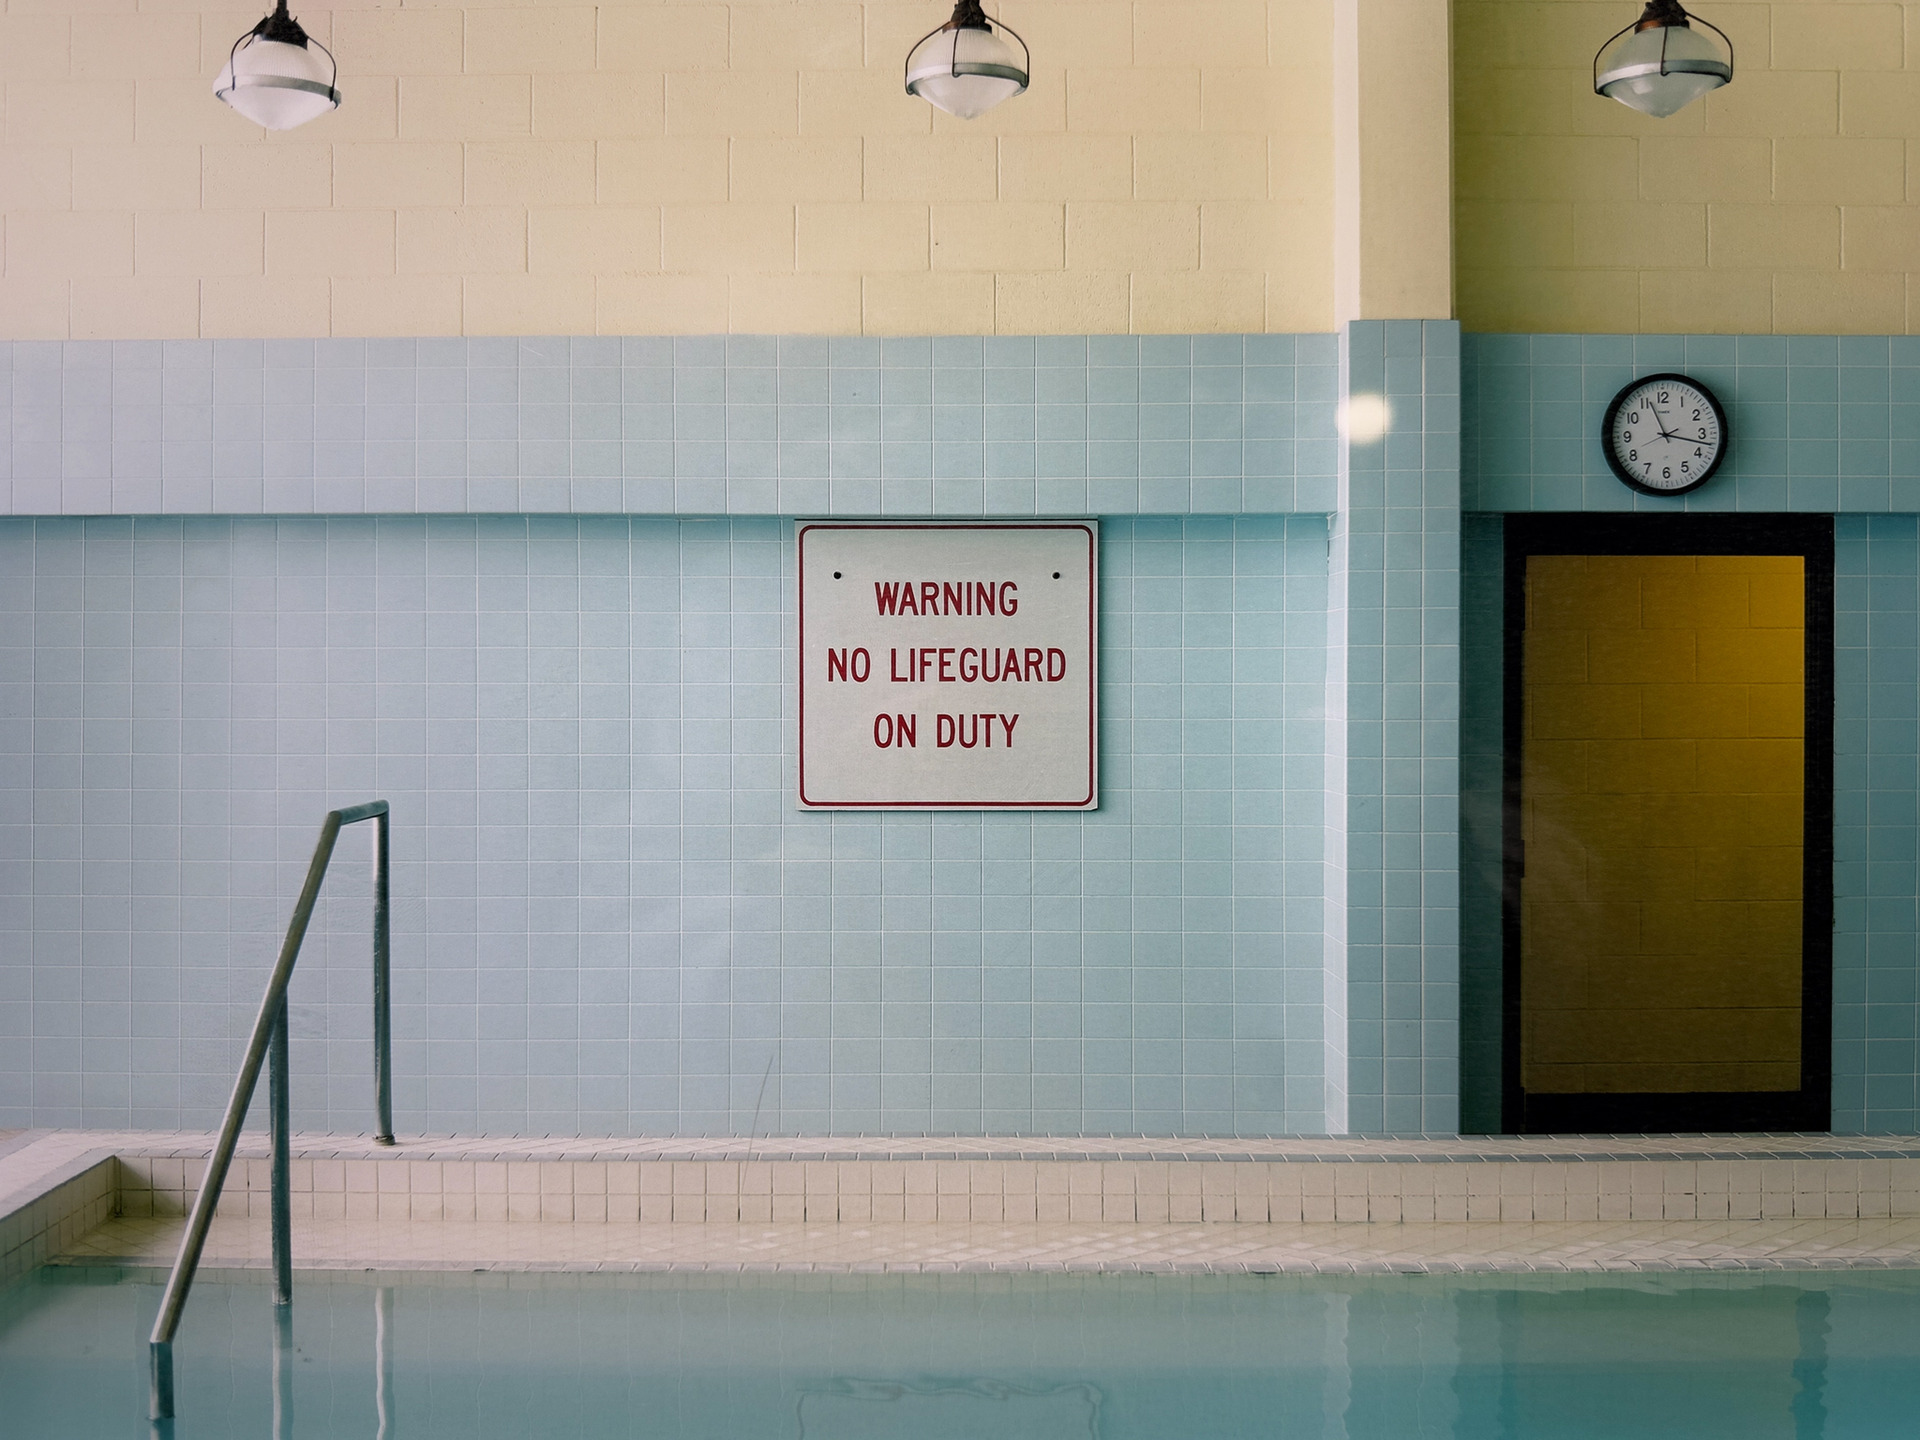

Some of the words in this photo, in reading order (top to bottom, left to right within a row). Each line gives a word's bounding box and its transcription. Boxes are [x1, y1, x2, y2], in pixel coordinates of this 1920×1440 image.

[1641, 397, 1649, 409] 11
[1657, 391, 1669, 403] 12
[1627, 412, 1639, 424] 10
[1692, 409, 1700, 421] 2
[1623, 431, 1632, 443] 9
[1698, 428, 1706, 439] 3
[1629, 449, 1638, 462] 8
[1694, 447, 1702, 458] 4
[1643, 463, 1652, 474] 7
[1663, 467, 1671, 479] 6
[1681, 461, 1689, 473] 5
[875, 581, 1018, 616] WARNING
[828, 648, 870, 682] NO
[891, 648, 1065, 682] LIFEGUARD
[874, 713, 916, 748] ON
[937, 714, 1018, 748] DUTY
